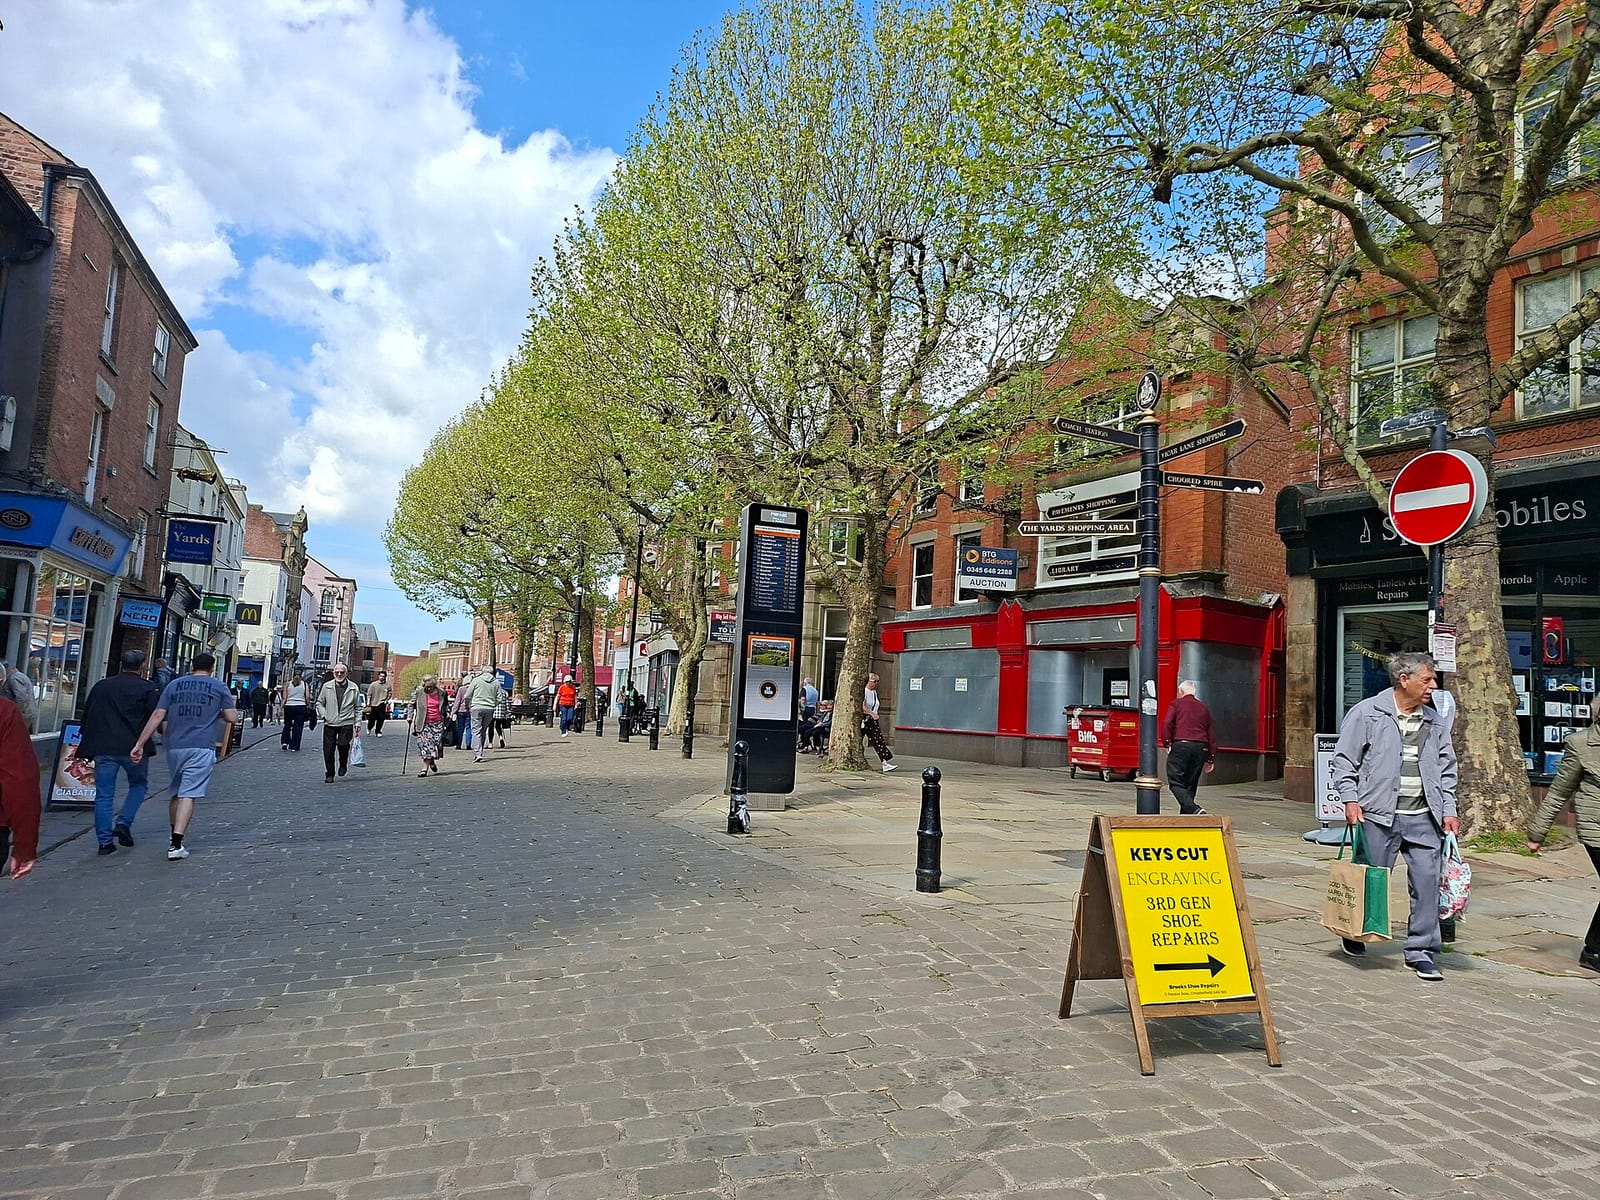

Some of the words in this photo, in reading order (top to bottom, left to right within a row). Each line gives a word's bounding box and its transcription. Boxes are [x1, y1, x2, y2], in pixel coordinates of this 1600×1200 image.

[1061, 422, 1082, 432] COACH
[1085, 427, 1109, 438] STATION
[1161, 448, 1178, 459] VICAR
[1180, 440, 1195, 452] LANE
[1196, 429, 1226, 446] SHOPPING
[1167, 475, 1201, 485] CROOKED
[1203, 479, 1223, 487] SPIRE
[1051, 504, 1084, 516] PAVEMENTS
[1086, 498, 1117, 510] SHOPPING
[1497, 496, 1587, 528] obiles
[1067, 524, 1104, 532] SHOPPING
[1105, 524, 1130, 532] AREA
[173, 531, 210, 545] Yards
[982, 558, 1013, 566] Eddisons
[1051, 565, 1080, 575] LIBRARY
[970, 579, 1007, 588] AUCTION
[1339, 582, 1375, 591] Mobiles,
[1377, 578, 1406, 588] Tablets
[1408, 577, 1417, 586] &
[1553, 574, 1588, 587] Apple
[1377, 590, 1409, 601] Repairs
[122, 611, 158, 623] NERO
[175, 680, 212, 693] NORTH
[169, 692, 213, 706] MARKET
[178, 705, 203, 717] OHIO
[1078, 730, 1098, 743] Biffa
[1130, 847, 1173, 861] KEYS
[1176, 847, 1208, 861] CUT
[1127, 871, 1222, 886] ENGRAVING
[1146, 896, 1176, 911] 3RD
[1180, 896, 1211, 910] GEN
[1162, 914, 1202, 928] SHOE
[1152, 931, 1219, 947] REPAIRS
